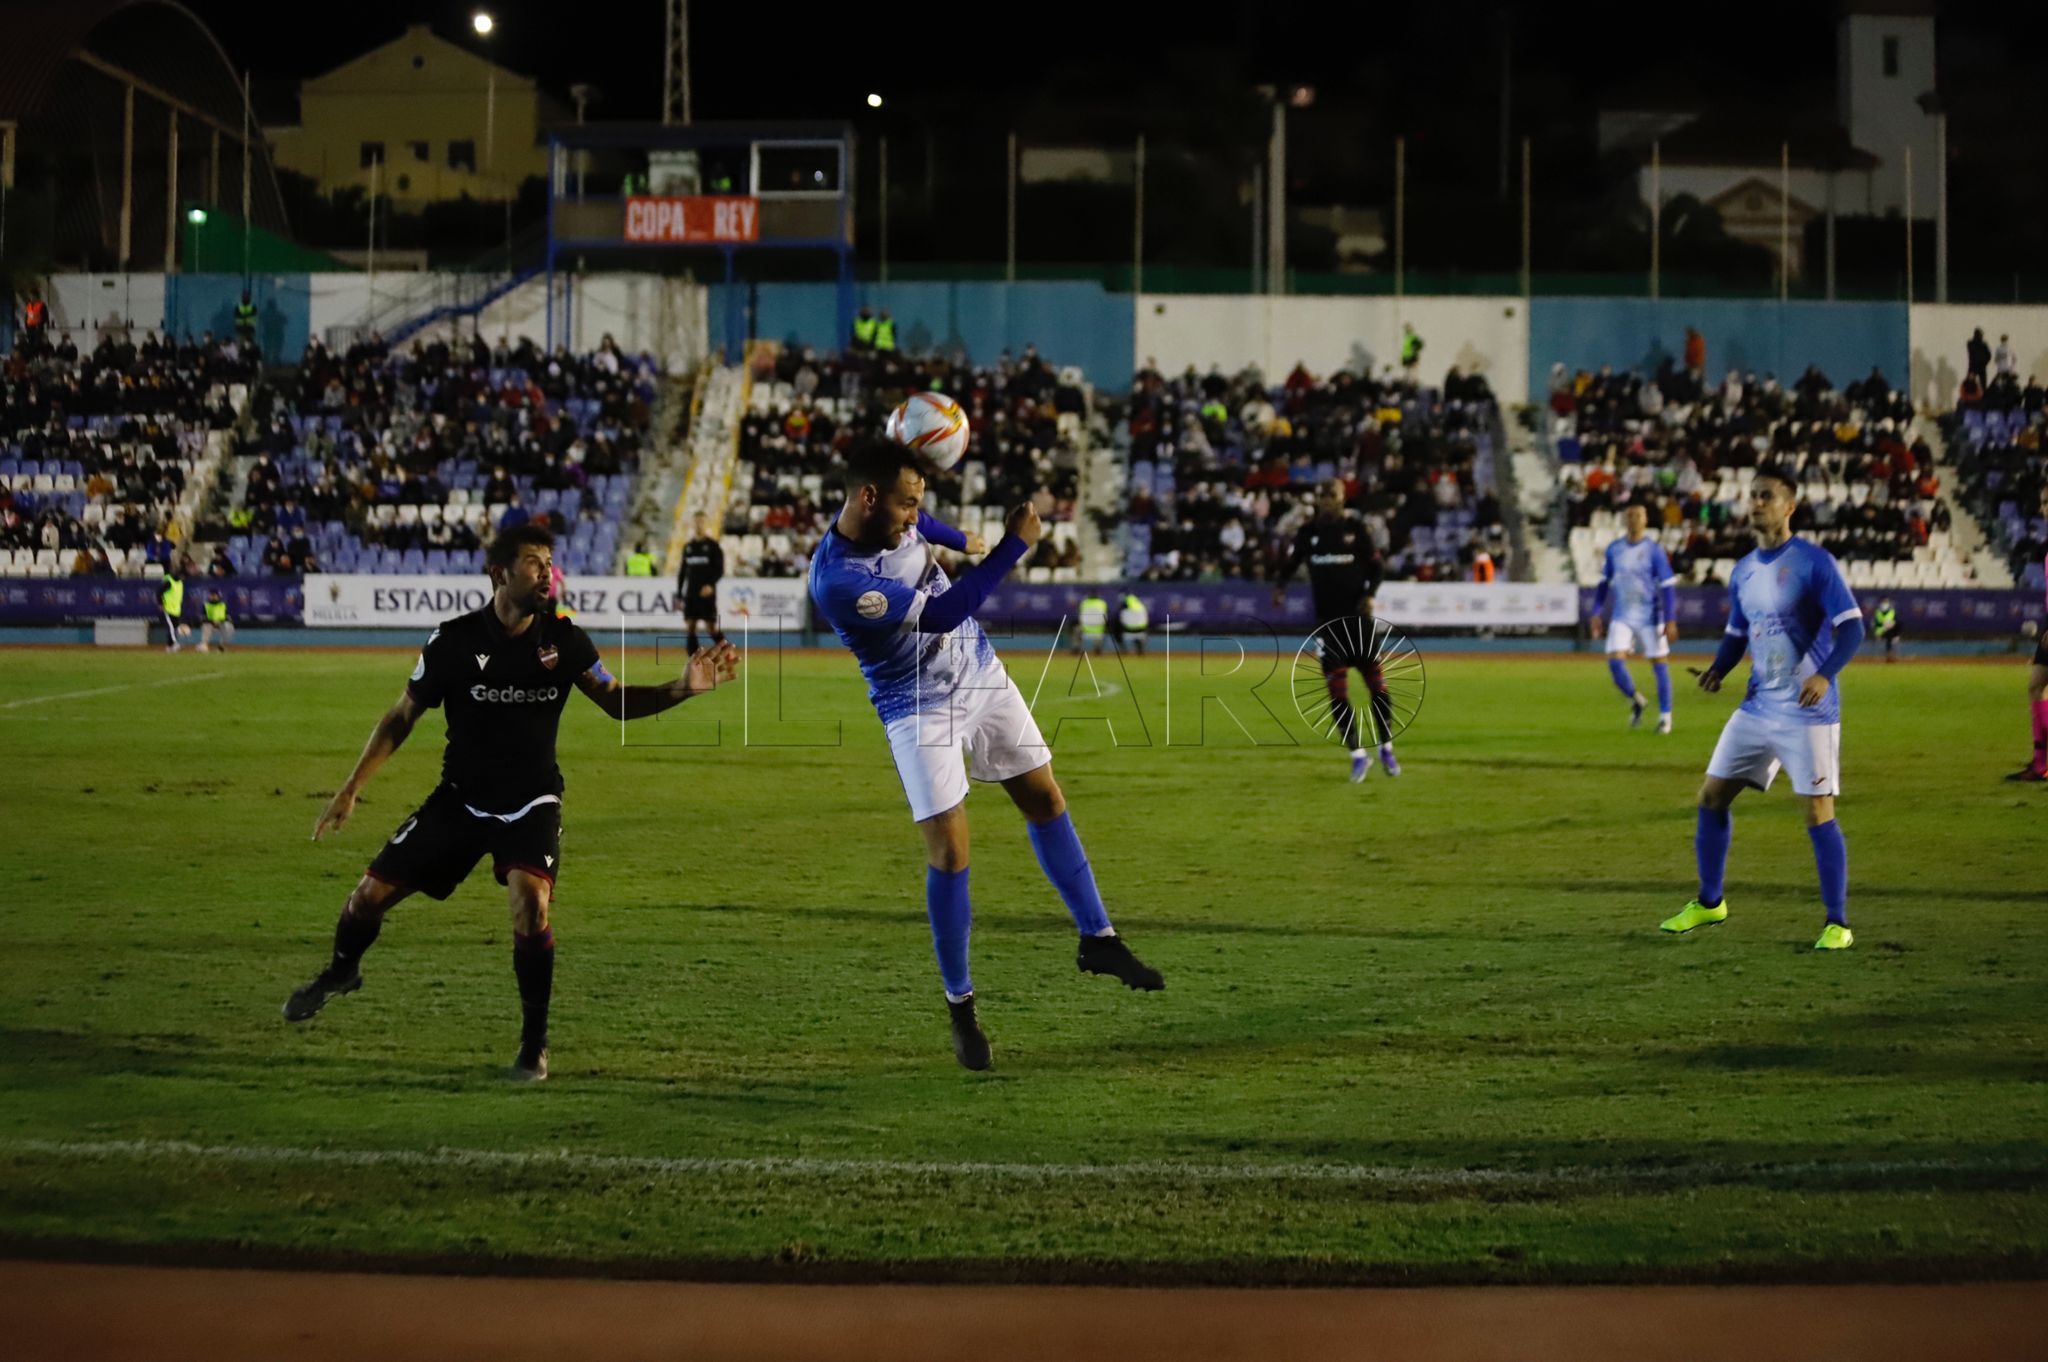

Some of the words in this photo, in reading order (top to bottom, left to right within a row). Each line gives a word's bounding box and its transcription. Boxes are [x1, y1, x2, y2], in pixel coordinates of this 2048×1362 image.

[627, 201, 686, 240] COPA
[713, 201, 756, 240] REY
[374, 588, 486, 612] ESTADIO
[470, 684, 559, 703] Gedesco
